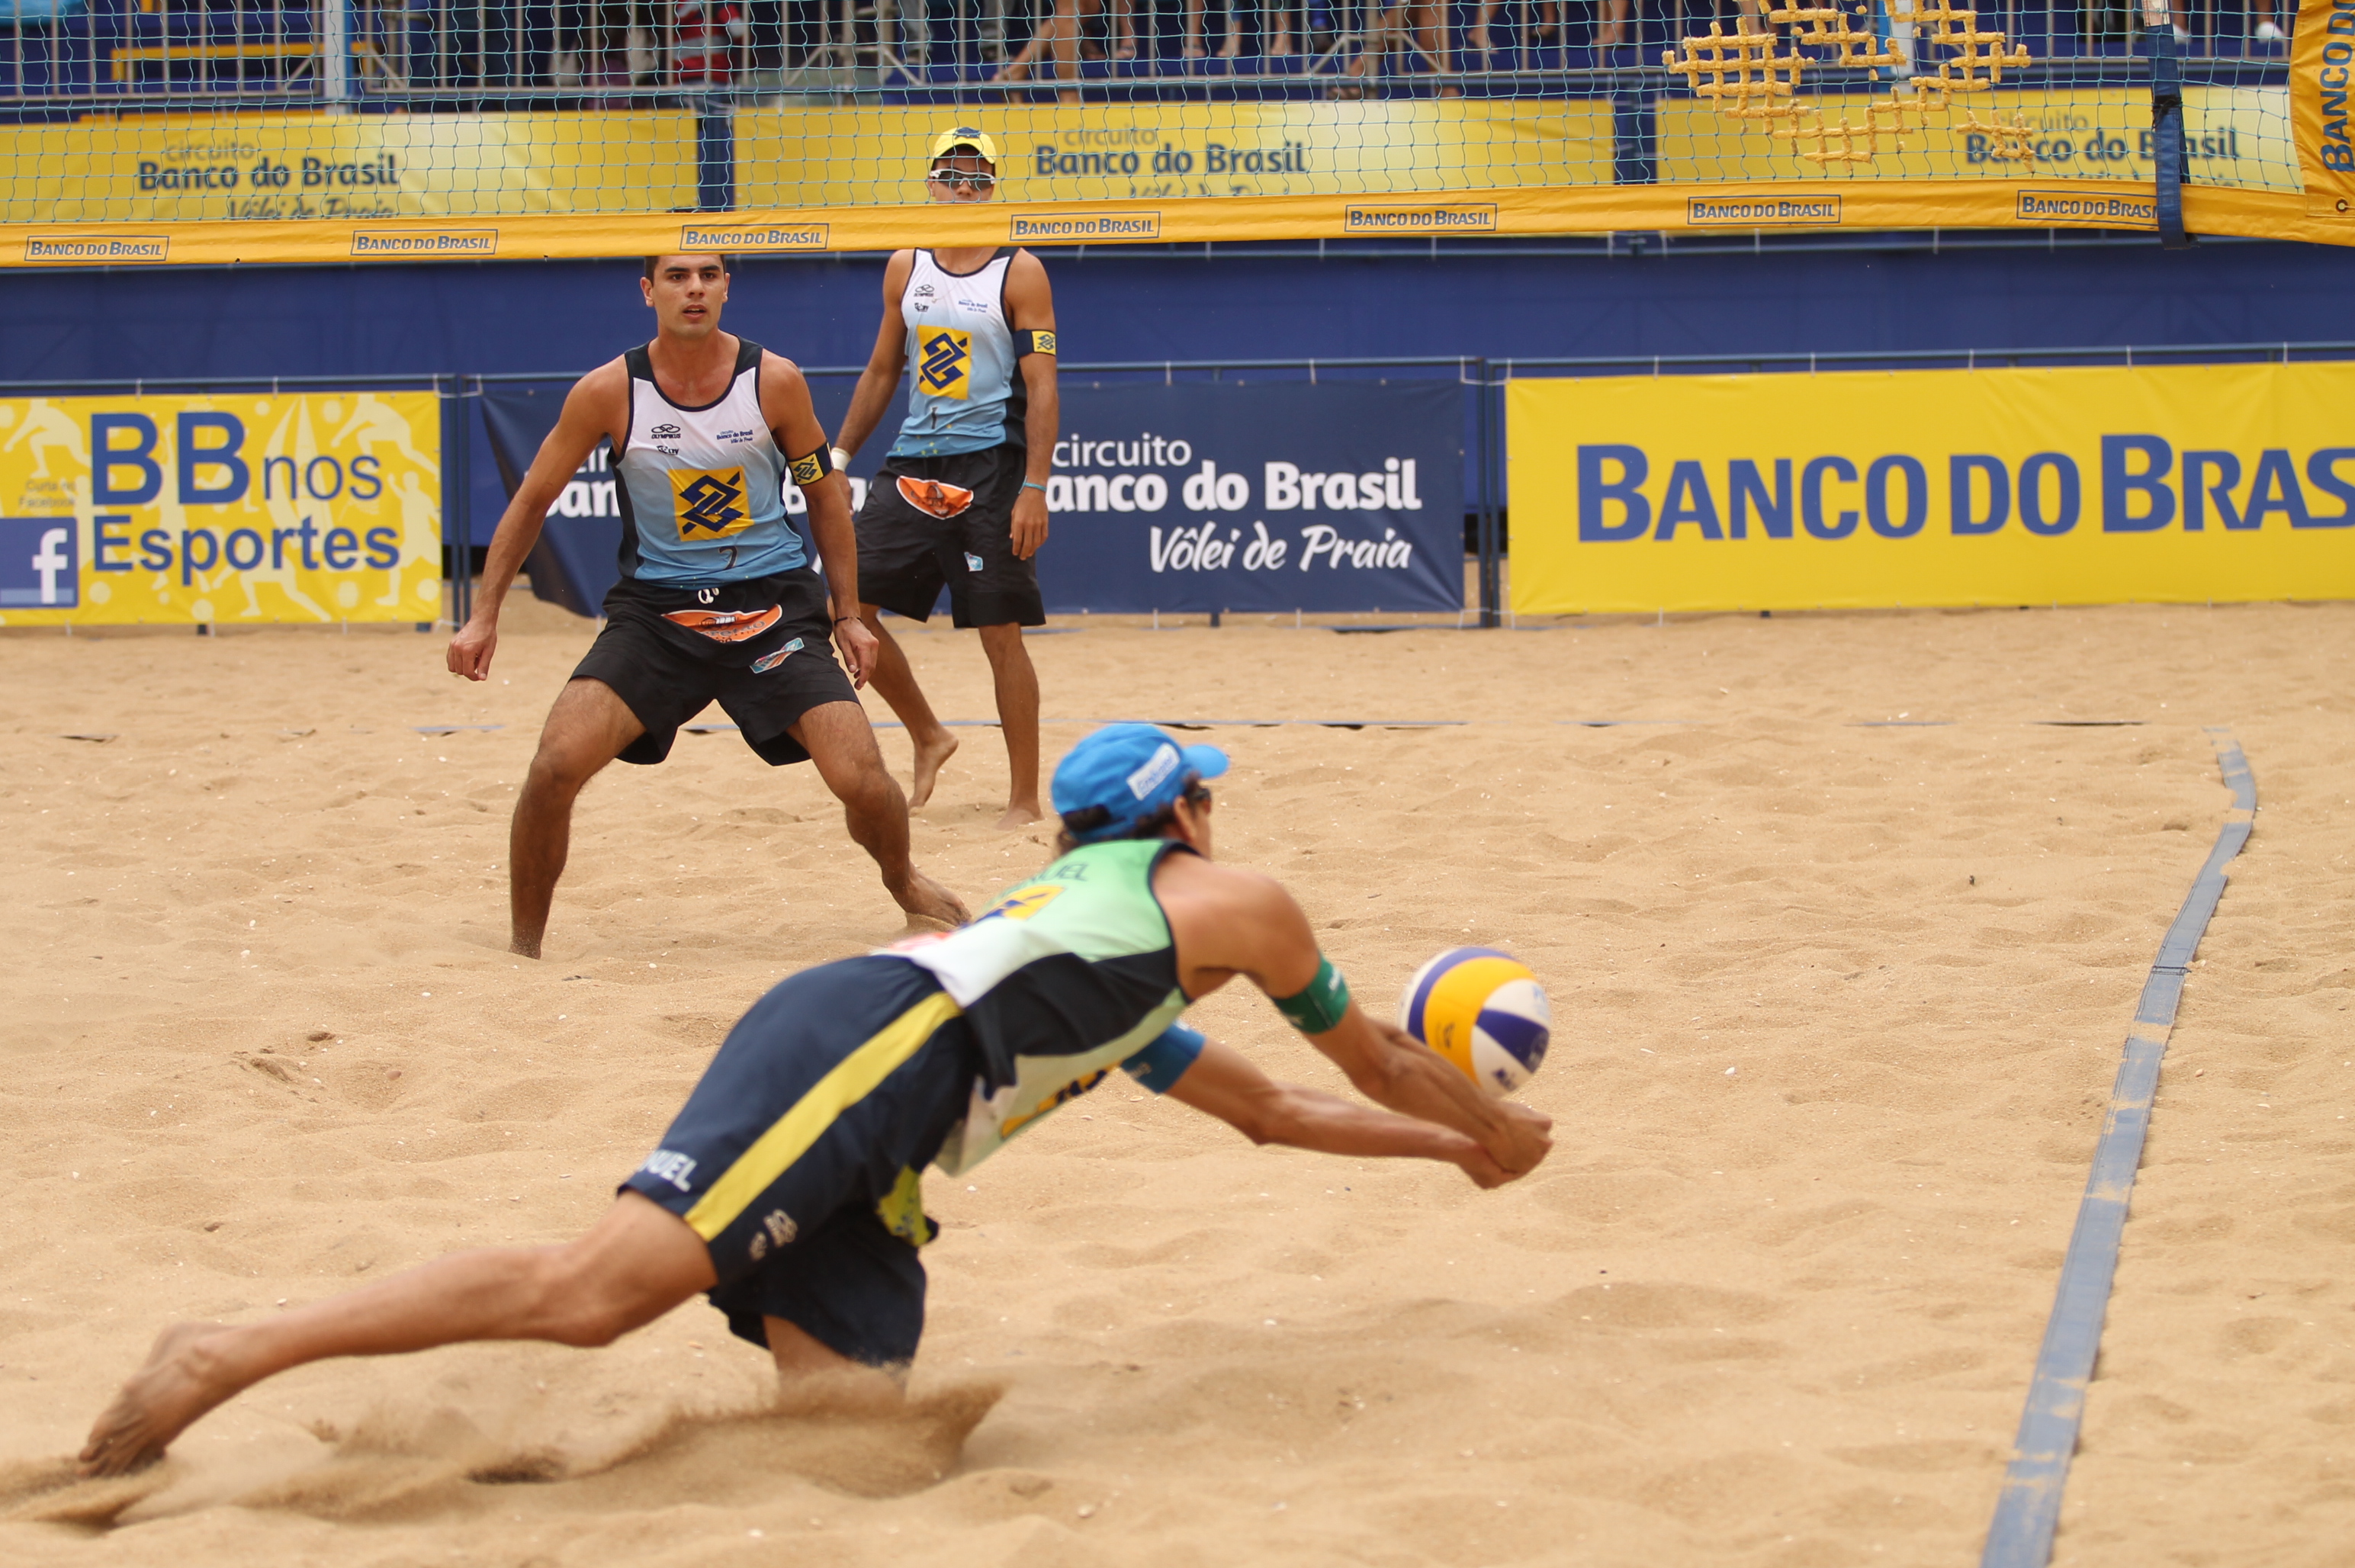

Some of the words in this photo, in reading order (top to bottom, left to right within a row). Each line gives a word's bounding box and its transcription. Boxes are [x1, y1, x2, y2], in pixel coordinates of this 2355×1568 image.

[2320, 41, 2355, 172] BANCO
[1997, 109, 2089, 132] cicuito
[1064, 124, 1156, 146] circuito
[2084, 130, 2126, 161] do
[165, 140, 255, 162] circuito
[1036, 145, 1139, 175] Banco
[1153, 143, 1194, 173] do
[1207, 140, 1306, 172] Brasil
[140, 162, 239, 191] Banco
[251, 156, 291, 188] do
[302, 154, 399, 186] Brasil
[1351, 210, 1408, 226] BANCO
[1411, 213, 1433, 225] DO
[1435, 210, 1491, 225] BRASIL
[1693, 203, 1751, 218] BANCO
[1754, 204, 1776, 217] DO
[1778, 201, 1836, 217] BRASIL
[2022, 196, 2080, 214] BANCO
[2084, 201, 2106, 215] DO
[2108, 199, 2157, 219] BRASI
[686, 230, 742, 245] BANCO
[744, 233, 766, 244] DO
[767, 230, 822, 243] BRASIL
[1016, 220, 1072, 235] BANCO
[1075, 220, 1097, 233] DO
[1099, 218, 1155, 233] BRASIL
[31, 241, 85, 255] BANCO
[86, 243, 108, 255] DO
[109, 241, 162, 255] BRASIL
[357, 236, 413, 250] BANCO
[414, 238, 435, 249] DO
[437, 235, 490, 249] BRASIL
[91, 412, 251, 506] BB
[263, 454, 383, 501] nos
[1052, 432, 1192, 468] circuito
[1046, 473, 1168, 512] anco
[1182, 460, 1249, 512] do
[1264, 457, 1422, 512] Brasil
[1576, 444, 1928, 543] BANCO
[1949, 451, 2080, 537] DO
[93, 514, 401, 586] Esportes
[1150, 520, 1242, 573] Vôlei
[1242, 519, 1287, 571] de
[1298, 523, 1413, 572] Praia
